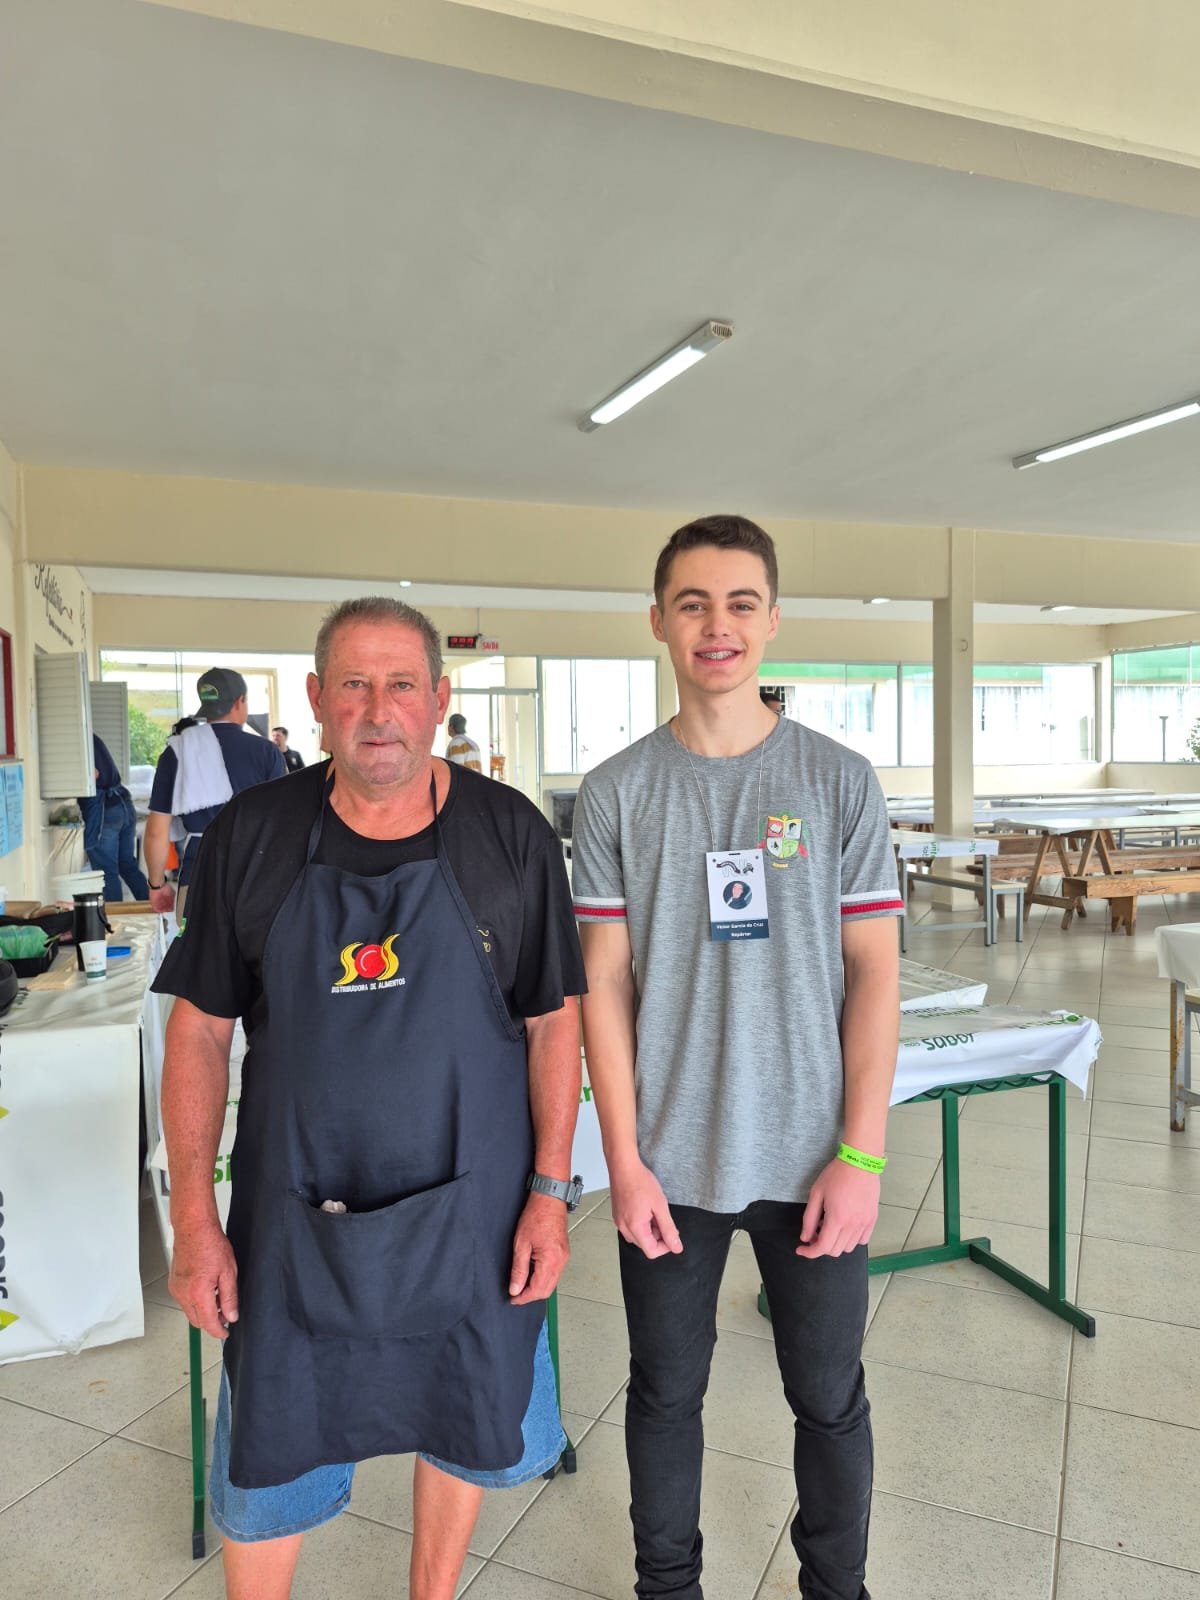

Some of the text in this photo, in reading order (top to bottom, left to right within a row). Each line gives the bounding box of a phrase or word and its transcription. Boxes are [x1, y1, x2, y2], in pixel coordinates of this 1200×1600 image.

[370, 982, 377, 991] DE
[378, 977, 406, 990] ALIMENTOS
[921, 1032, 974, 1051] sabor
